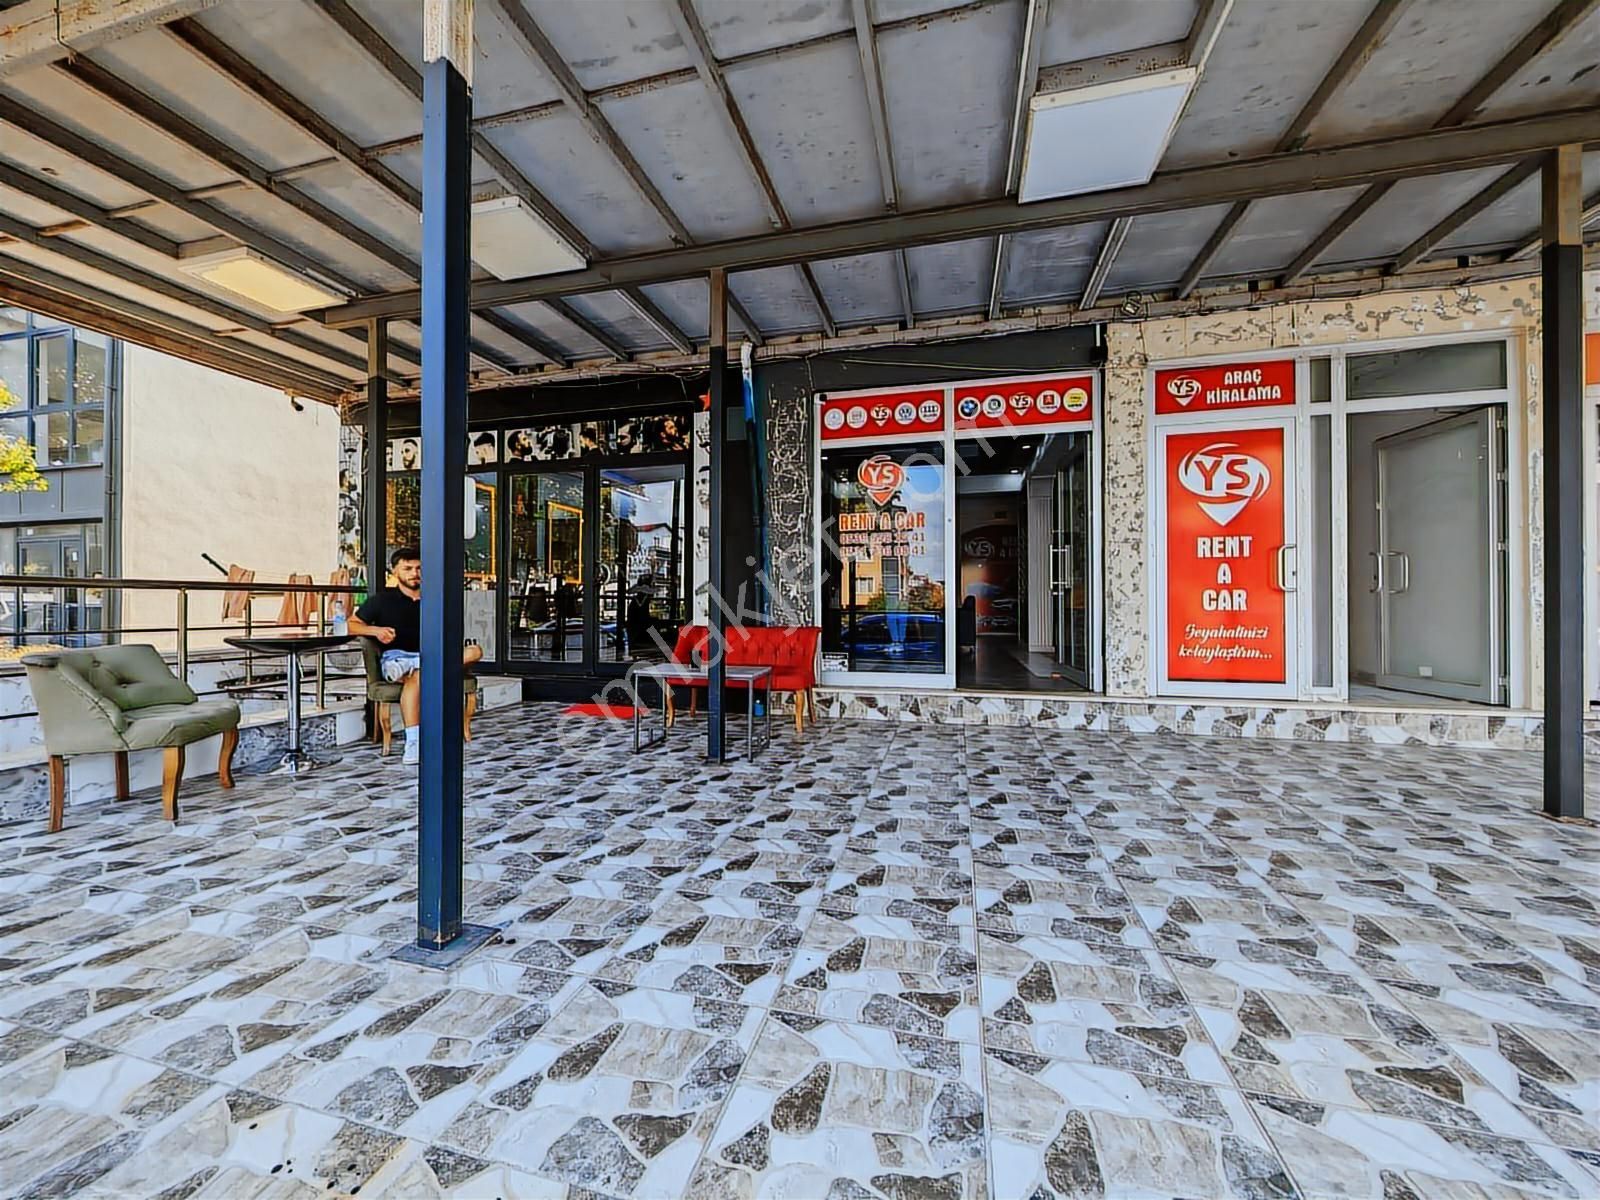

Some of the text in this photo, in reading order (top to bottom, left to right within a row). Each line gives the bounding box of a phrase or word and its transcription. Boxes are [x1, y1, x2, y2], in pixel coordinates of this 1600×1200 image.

[1173, 380, 1195, 394] YS
[1224, 369, 1262, 386] ARAÇ
[1014, 396, 1029, 406] YS
[1206, 385, 1282, 404] KİRALAMA
[874, 406, 888, 417] YS
[868, 465, 895, 485] YS
[1194, 458, 1250, 491] YS
[839, 511, 926, 531] RENT A CAR
[1197, 536, 1252, 558] RENT
[1217, 563, 1232, 584] A
[1202, 589, 1248, 611] CAR
